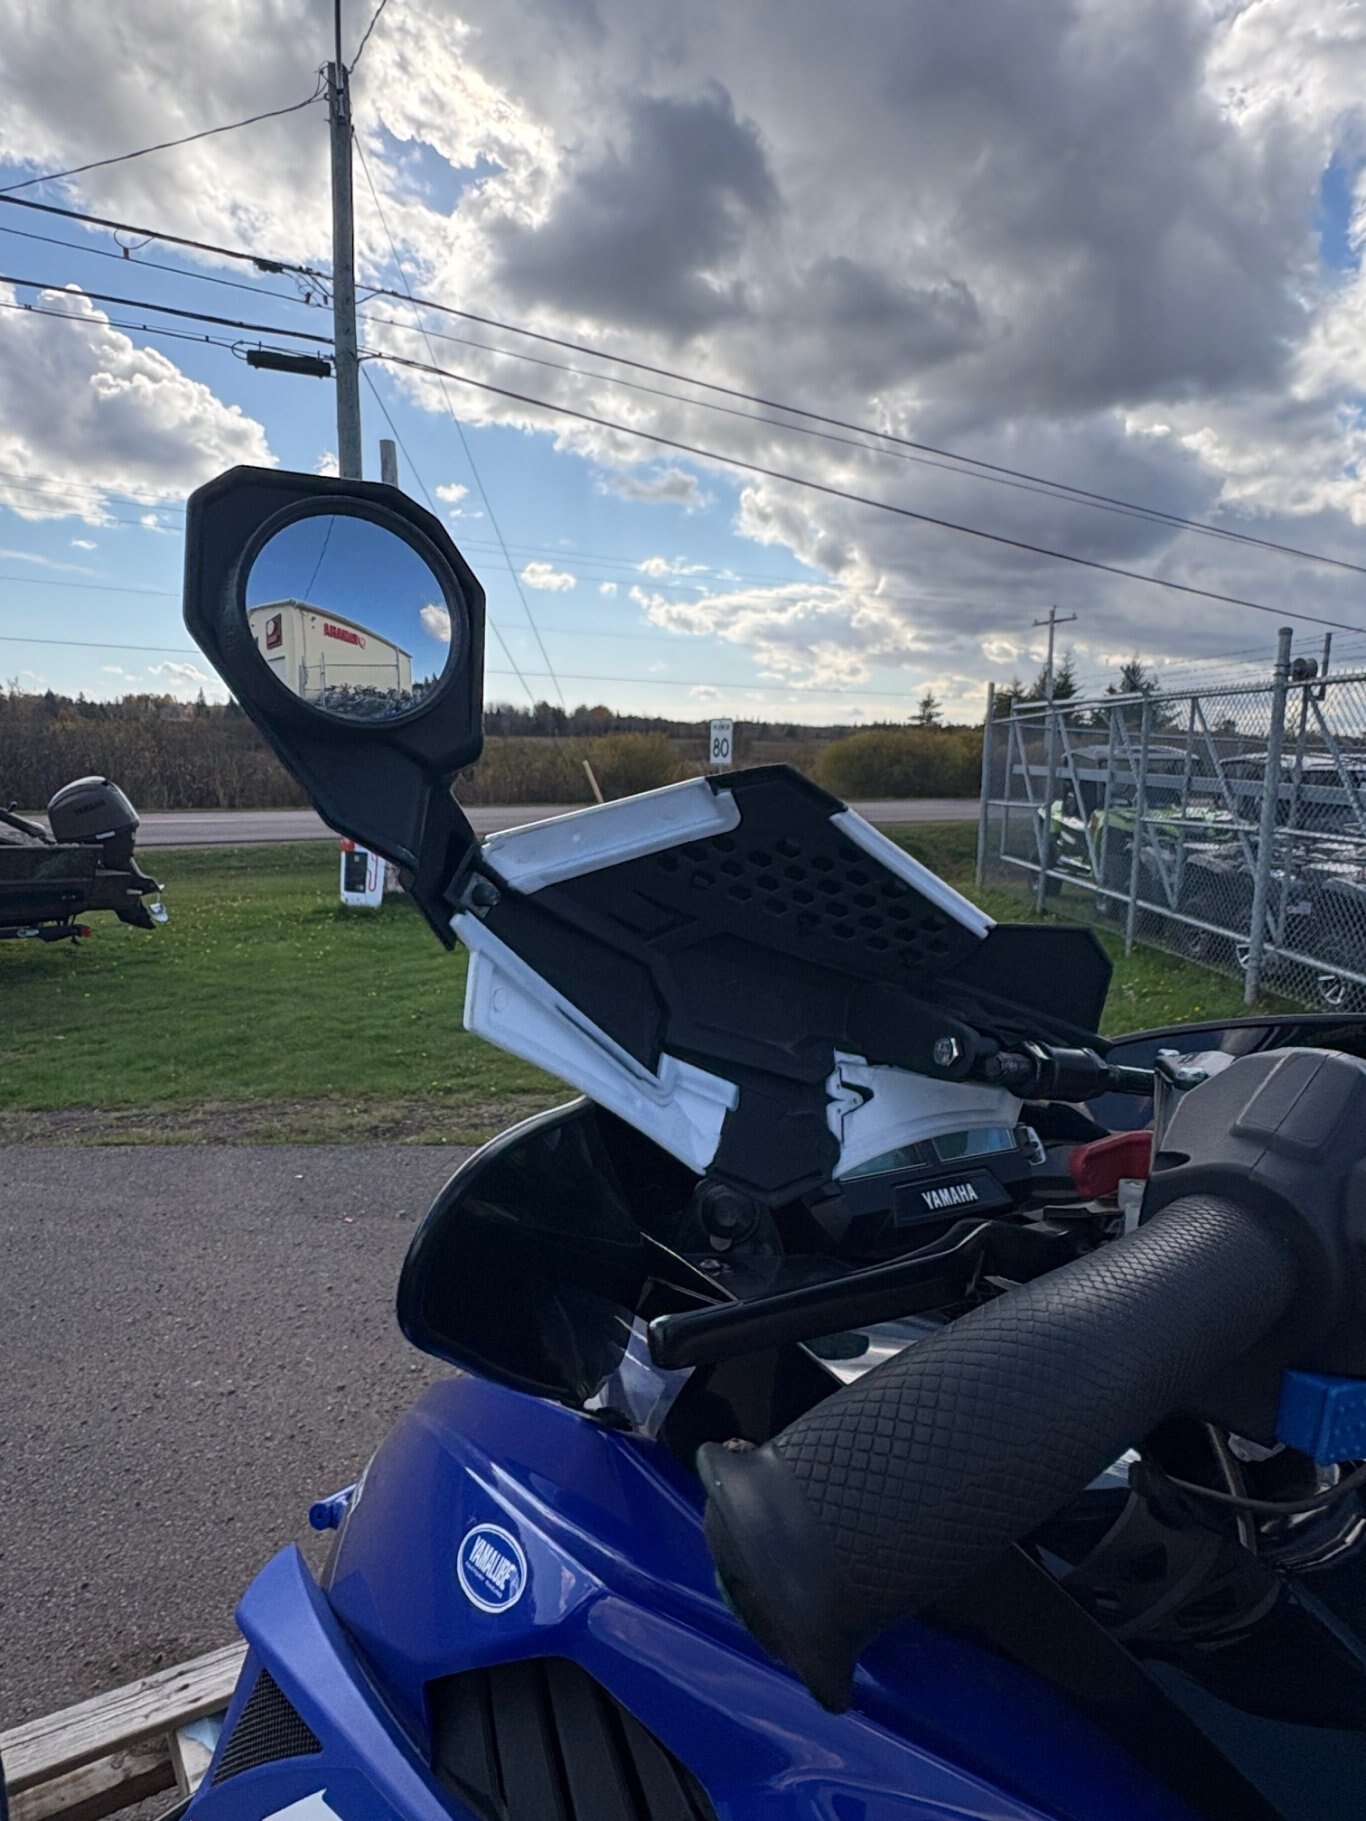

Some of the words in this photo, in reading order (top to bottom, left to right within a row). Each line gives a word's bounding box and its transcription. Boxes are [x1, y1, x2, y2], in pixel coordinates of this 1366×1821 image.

[712, 737, 730, 758] 80
[921, 1183, 979, 1210] YAMAHA
[468, 1535, 515, 1591] YAMALUBE
